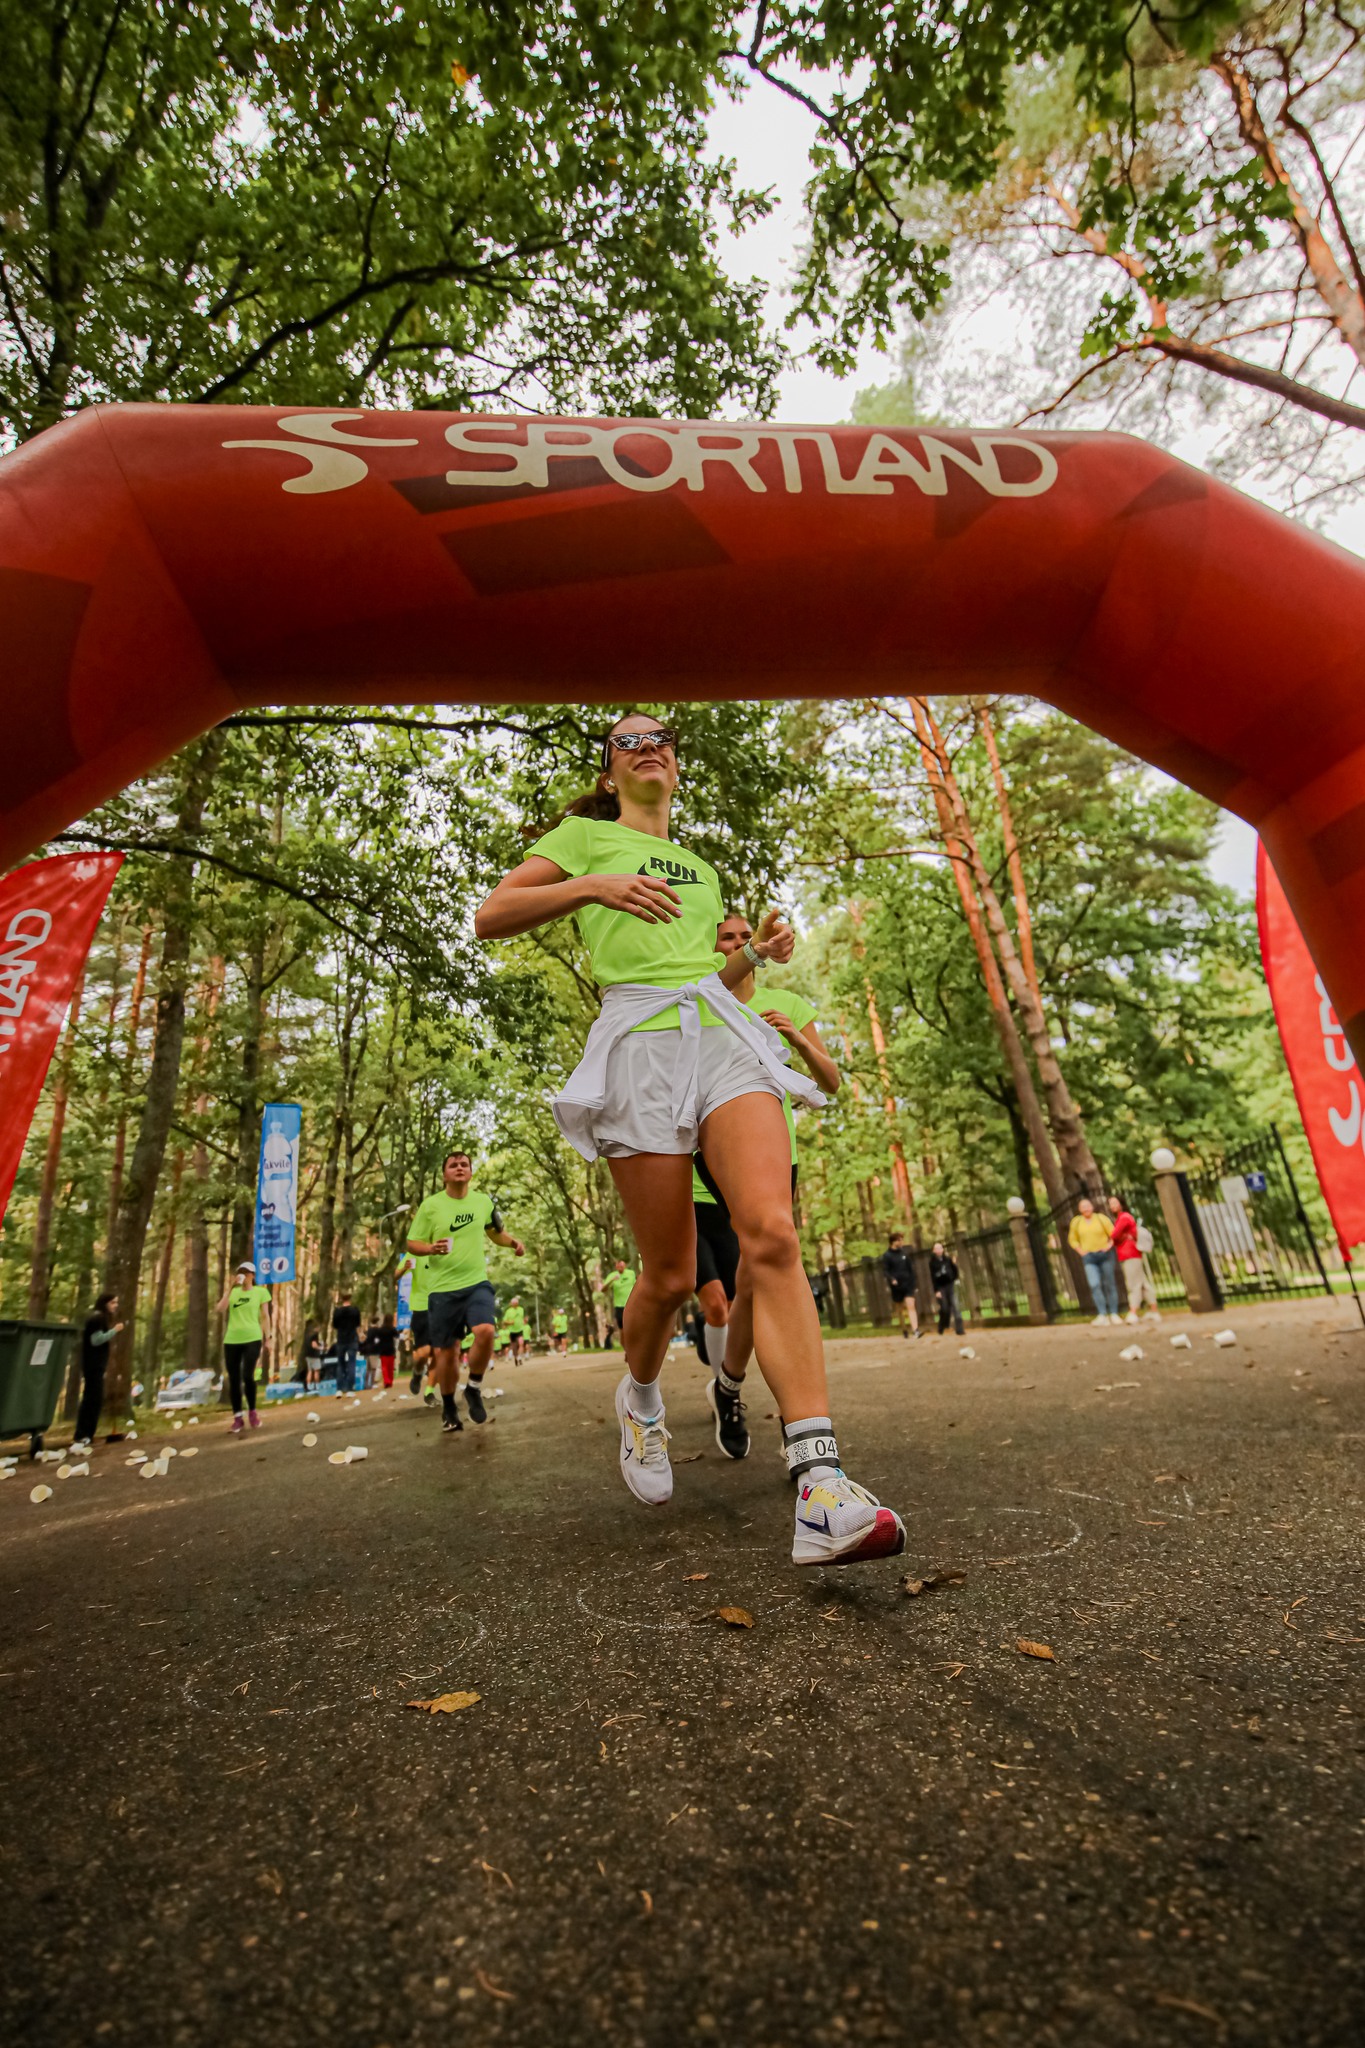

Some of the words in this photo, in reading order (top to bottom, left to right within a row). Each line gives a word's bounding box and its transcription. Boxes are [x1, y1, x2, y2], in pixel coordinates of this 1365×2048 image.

[444, 421, 1059, 498] SPORTLAND
[649, 856, 698, 882] RUN
[455, 1213, 474, 1224] RUN
